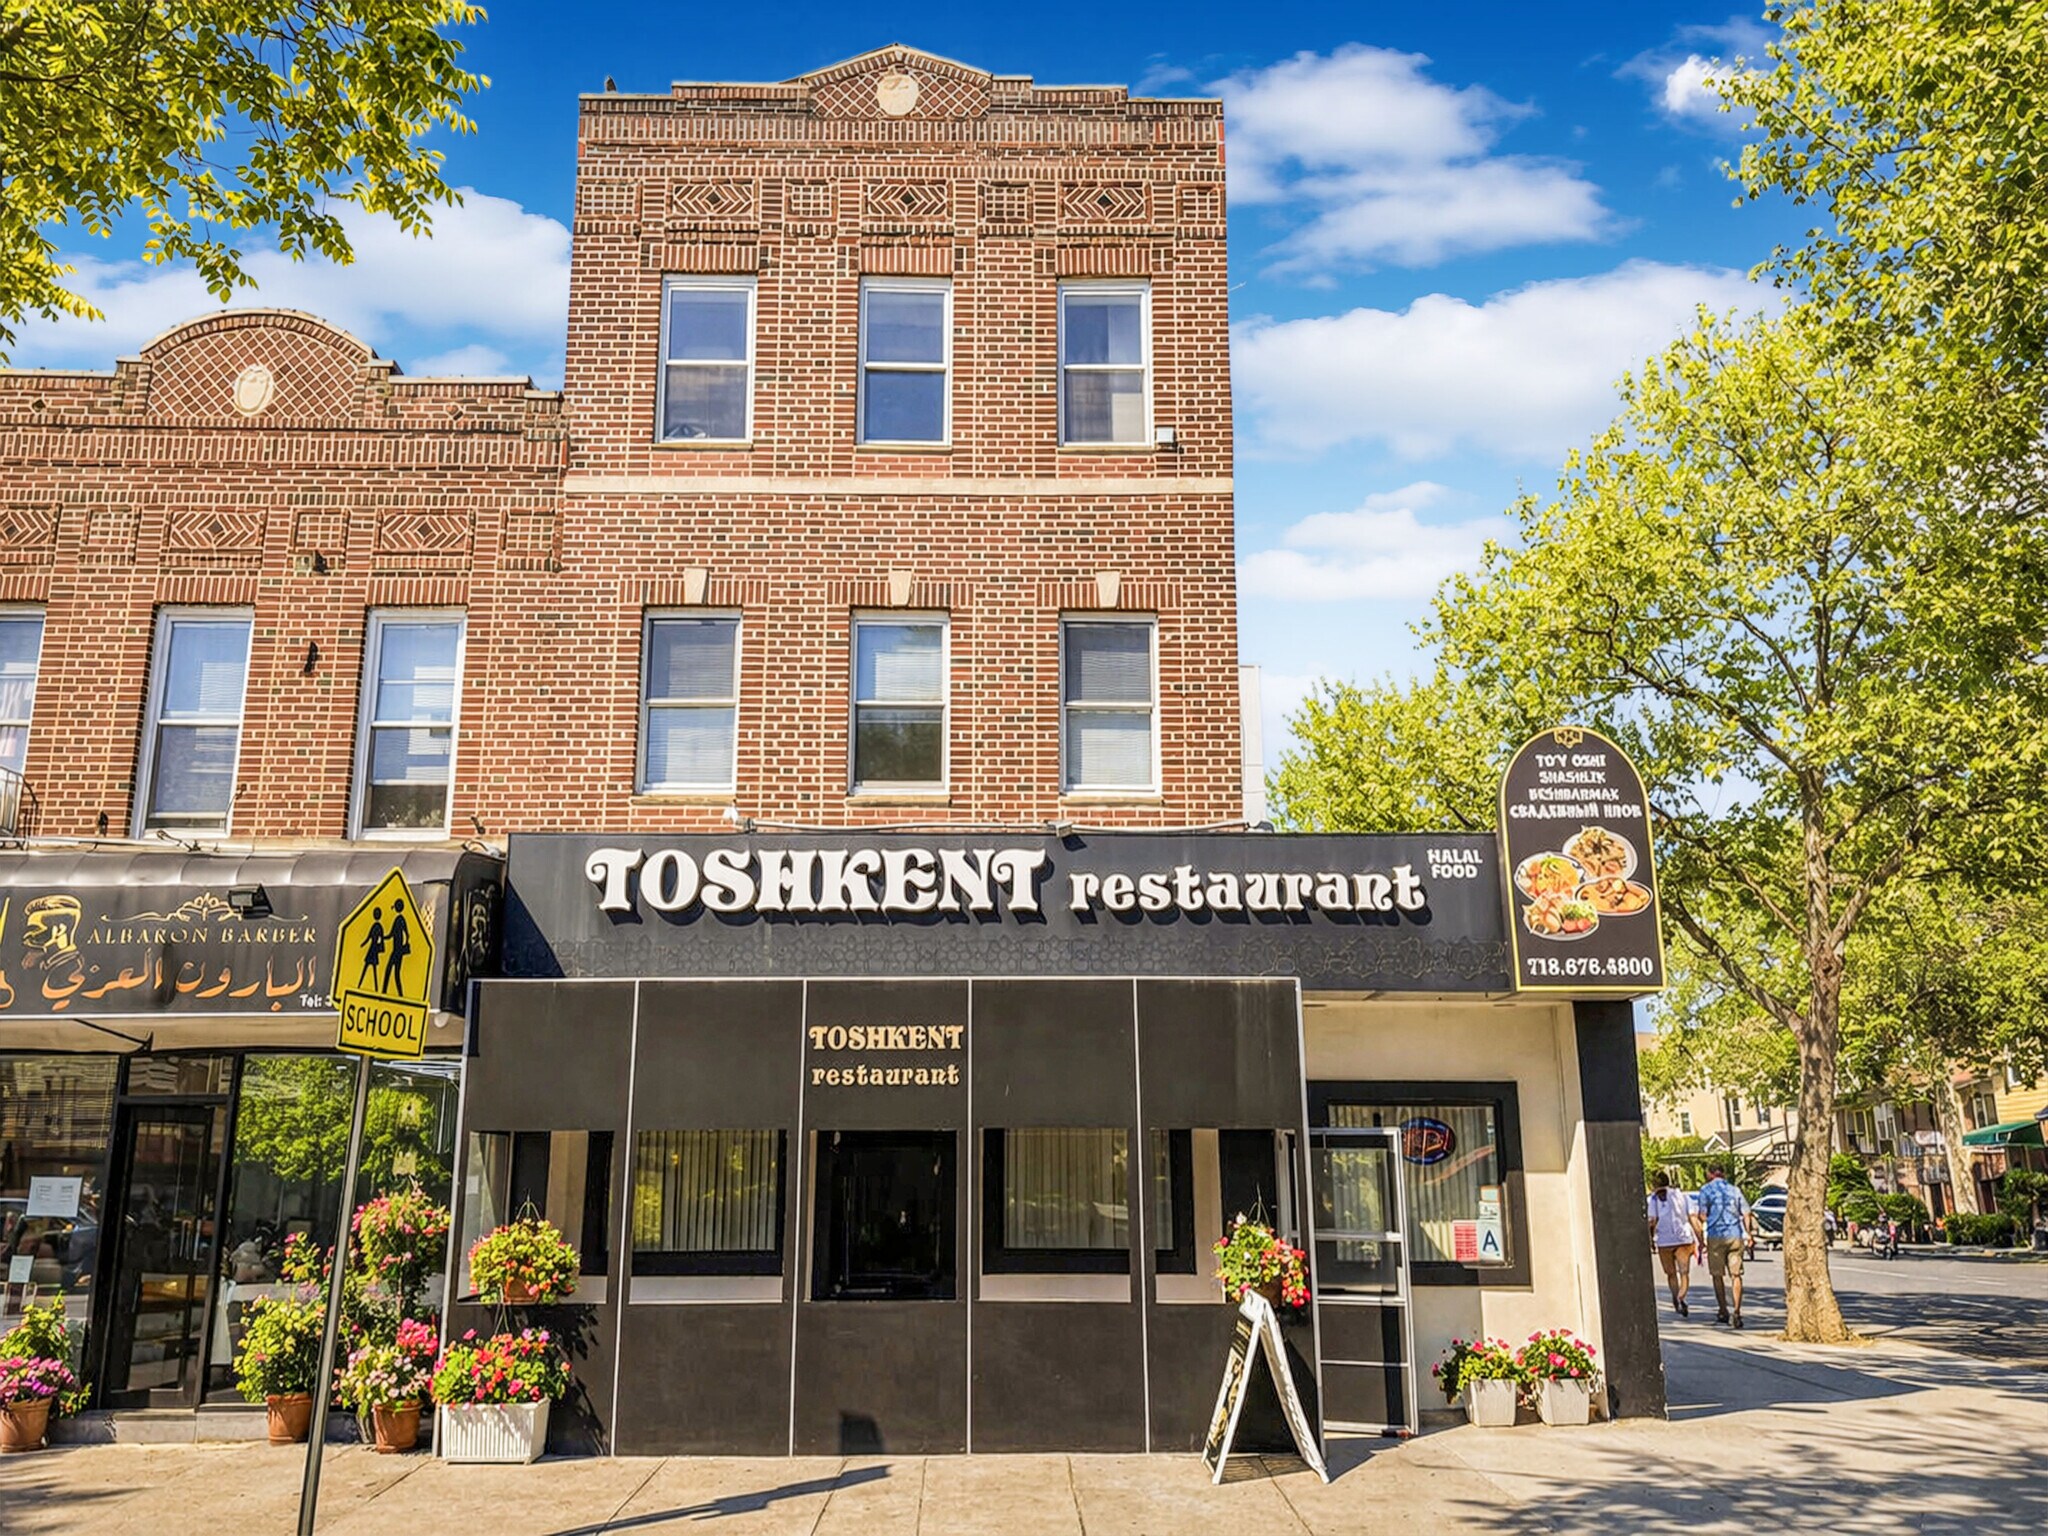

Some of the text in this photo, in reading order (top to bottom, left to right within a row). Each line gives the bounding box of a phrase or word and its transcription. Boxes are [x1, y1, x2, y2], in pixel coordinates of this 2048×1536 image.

[1427, 848, 1483, 864] HALAL
[585, 848, 1426, 913] TOSHKENT restaurant
[1431, 864, 1478, 879] FOOD
[86, 926, 317, 945] ALBARON BARBER
[345, 1004, 418, 1041] SCHOOL
[808, 1024, 964, 1050] TOSHKENT
[811, 1063, 960, 1086] restaurant
[1482, 1229, 1499, 1252] A
